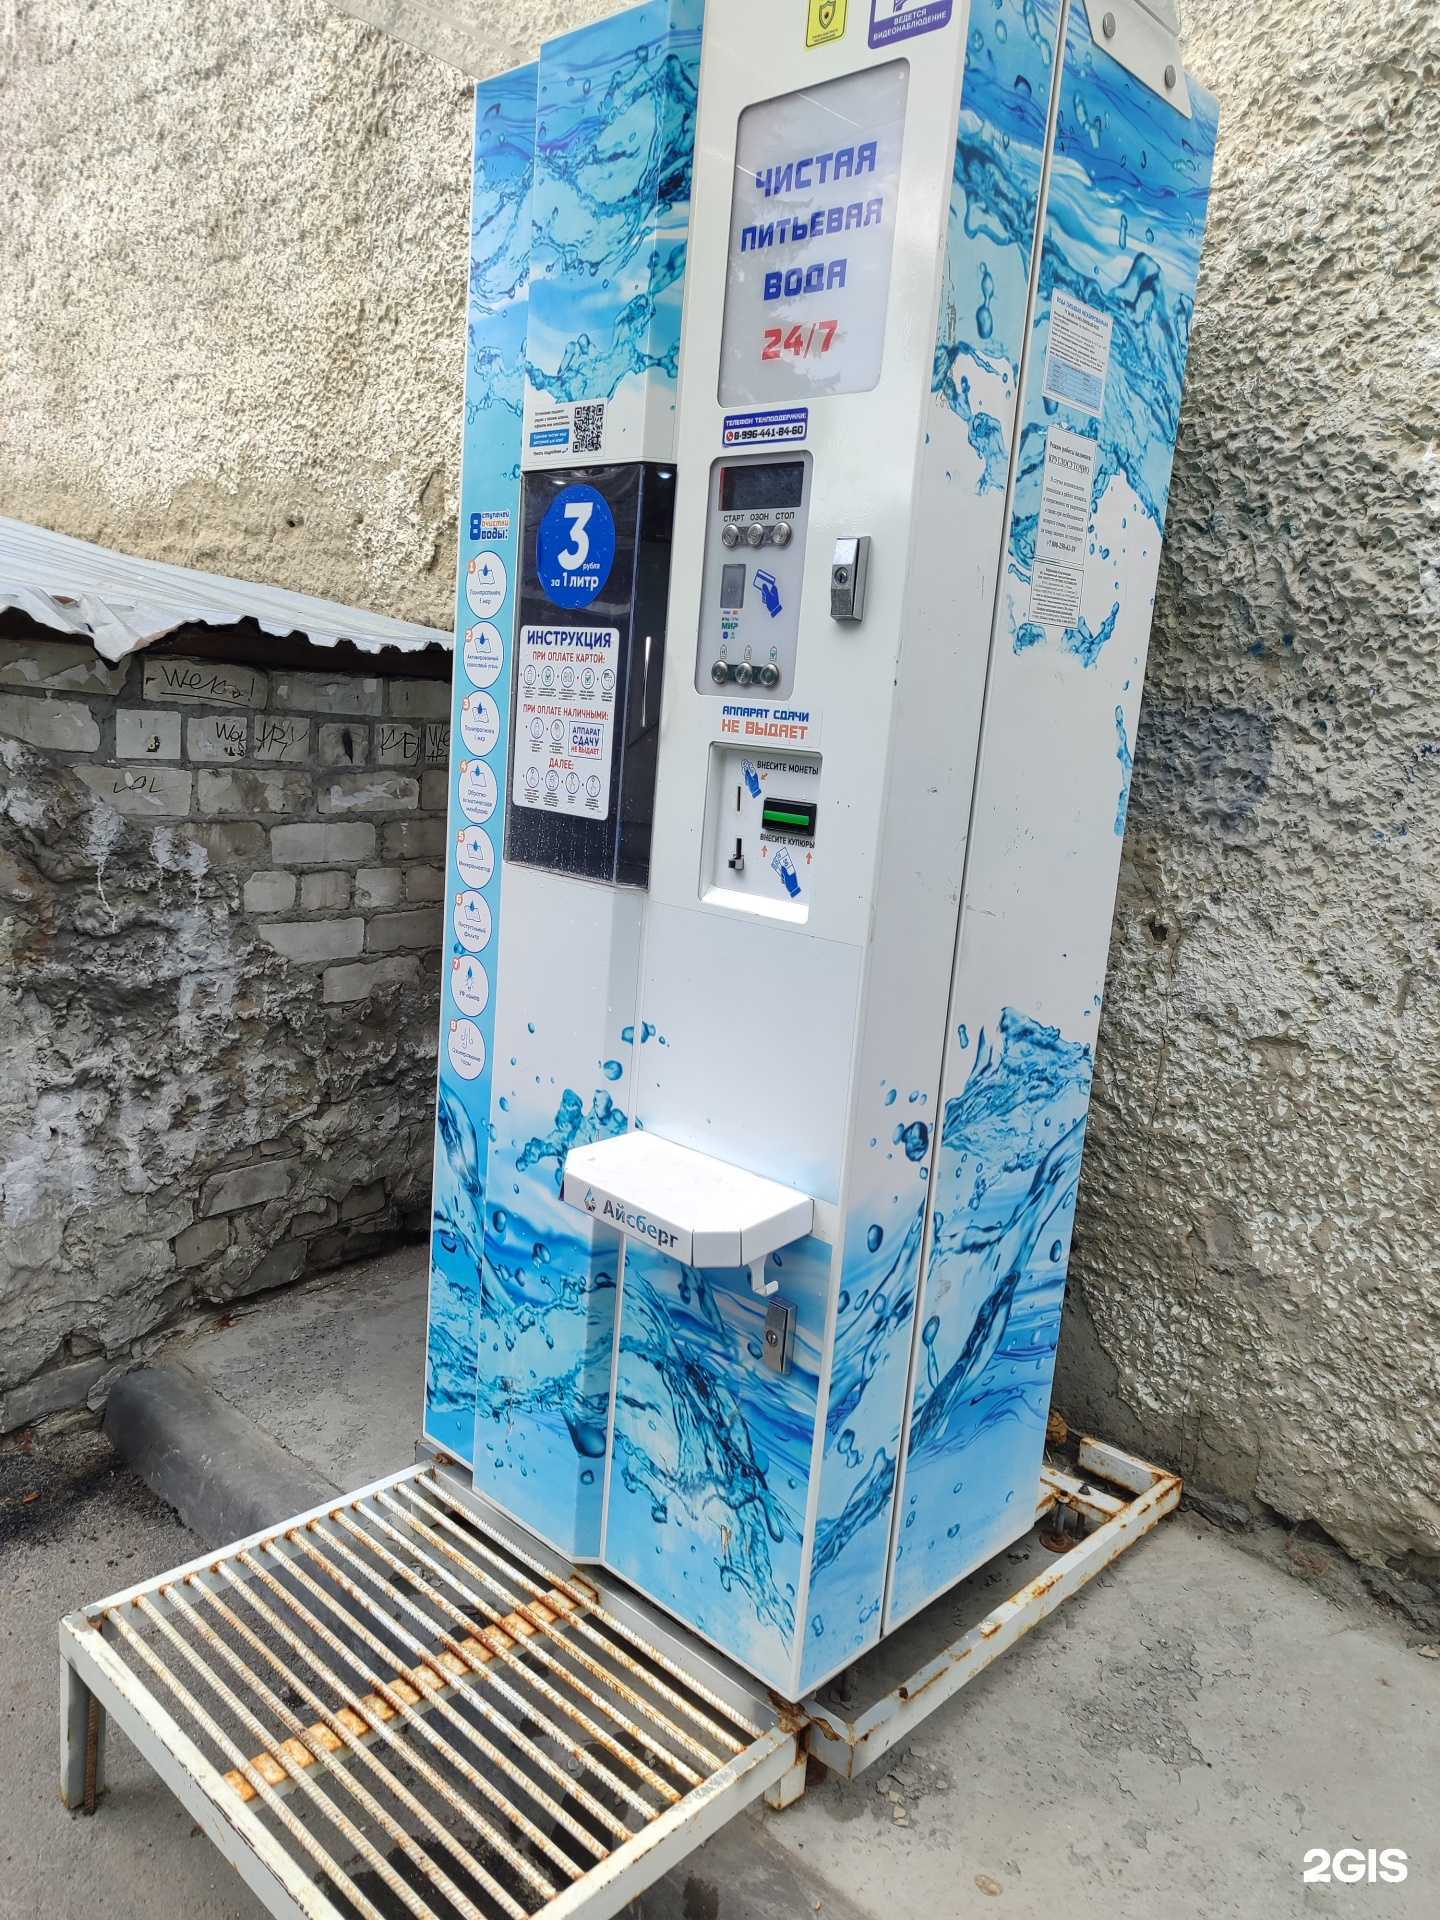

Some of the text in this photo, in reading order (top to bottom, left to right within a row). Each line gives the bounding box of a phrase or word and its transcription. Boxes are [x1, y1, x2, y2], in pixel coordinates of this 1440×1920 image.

[893, 8, 927, 25] ВЕДЕТСЯ
[873, 10, 947, 41] ВИДЕОНАБЛЮДЕНИЕ
[755, 141, 878, 198] ЧИСТАЯ
[741, 198, 884, 252] ПИТЬЕВАЯ
[763, 259, 847, 301] ВОДА
[761, 320, 838, 360] 24/7
[726, 417, 753, 426] ТЕЛЕФОН
[723, 511, 795, 522] СТАРТ ОЗОН СТОП
[470, 513, 481, 540] 8
[482, 528, 508, 539] воды:
[557, 502, 593, 570] 3
[551, 572, 599, 591] за 1 литр
[527, 630, 611, 649] ИНСТРУКЦИЯ
[533, 651, 605, 663] ПРИ ОПЛАТЕ КАРТОЙ:
[523, 704, 608, 720] ПРИ ОПЛАТЕ НАЛИЧНЫМИ:
[722, 705, 809, 722] АППАРАТ СДАЧИ
[572, 726, 600, 736] АППАРАТ
[721, 719, 808, 739] НЕ ВЫДАЕТ
[572, 735, 599, 746] СДАЧУ
[578, 747, 599, 755] ВЫДАЕТ
[549, 758, 573, 770] ДАЛЕЕ:
[757, 761, 819, 775] ВНЕСИТЕ МОНЕТЫ
[760, 833, 815, 849] ВНЕСИТЕ КУПЮРЫ
[603, 1199, 679, 1249] Айсберг
